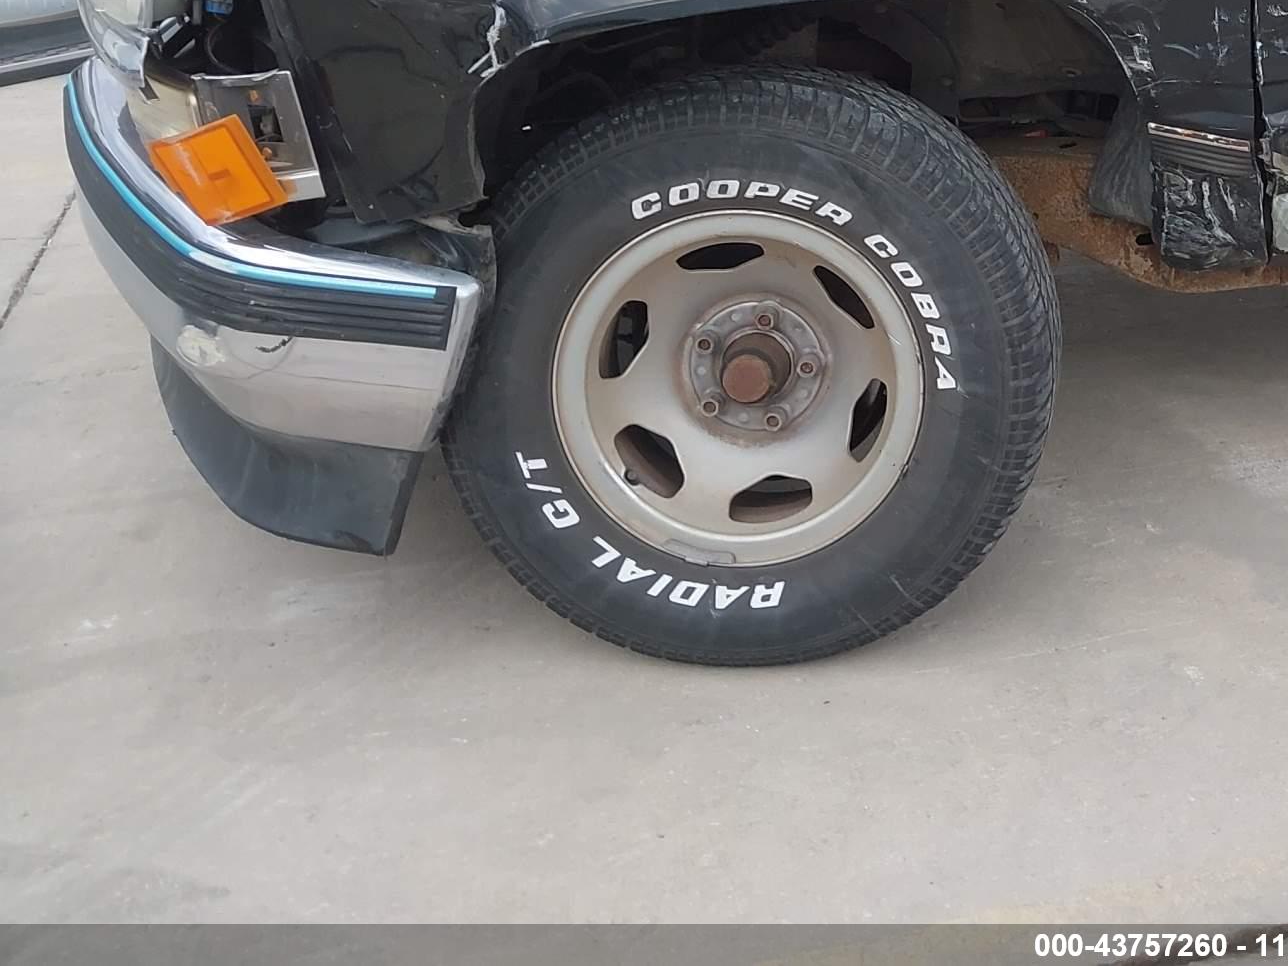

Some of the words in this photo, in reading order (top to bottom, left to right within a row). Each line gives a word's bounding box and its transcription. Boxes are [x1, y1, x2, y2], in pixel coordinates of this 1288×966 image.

[632, 179, 853, 226] COOPER
[864, 234, 958, 391] COBRA
[514, 451, 580, 529] G/T
[590, 536, 785, 610] RADIAL
